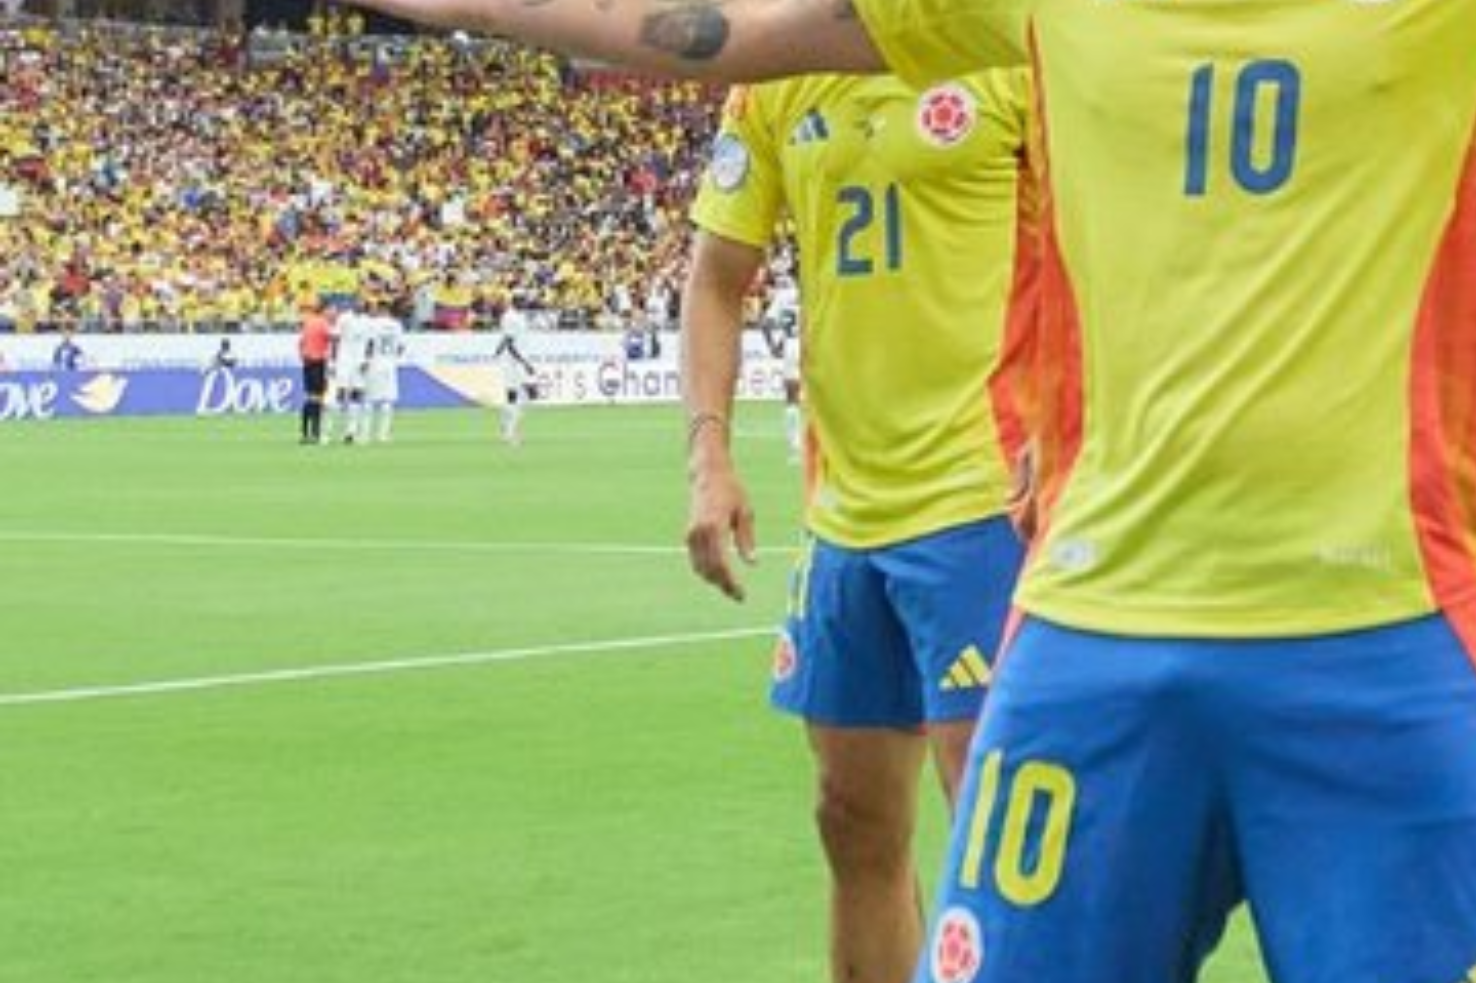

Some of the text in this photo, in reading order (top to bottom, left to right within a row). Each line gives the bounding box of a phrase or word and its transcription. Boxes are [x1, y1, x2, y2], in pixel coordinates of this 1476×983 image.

[1184, 59, 1300, 197] 10
[836, 181, 900, 277] 21
[0, 380, 57, 418] ove
[196, 367, 293, 414] Dove
[600, 362, 681, 397] Chan
[959, 748, 1077, 906] 10
